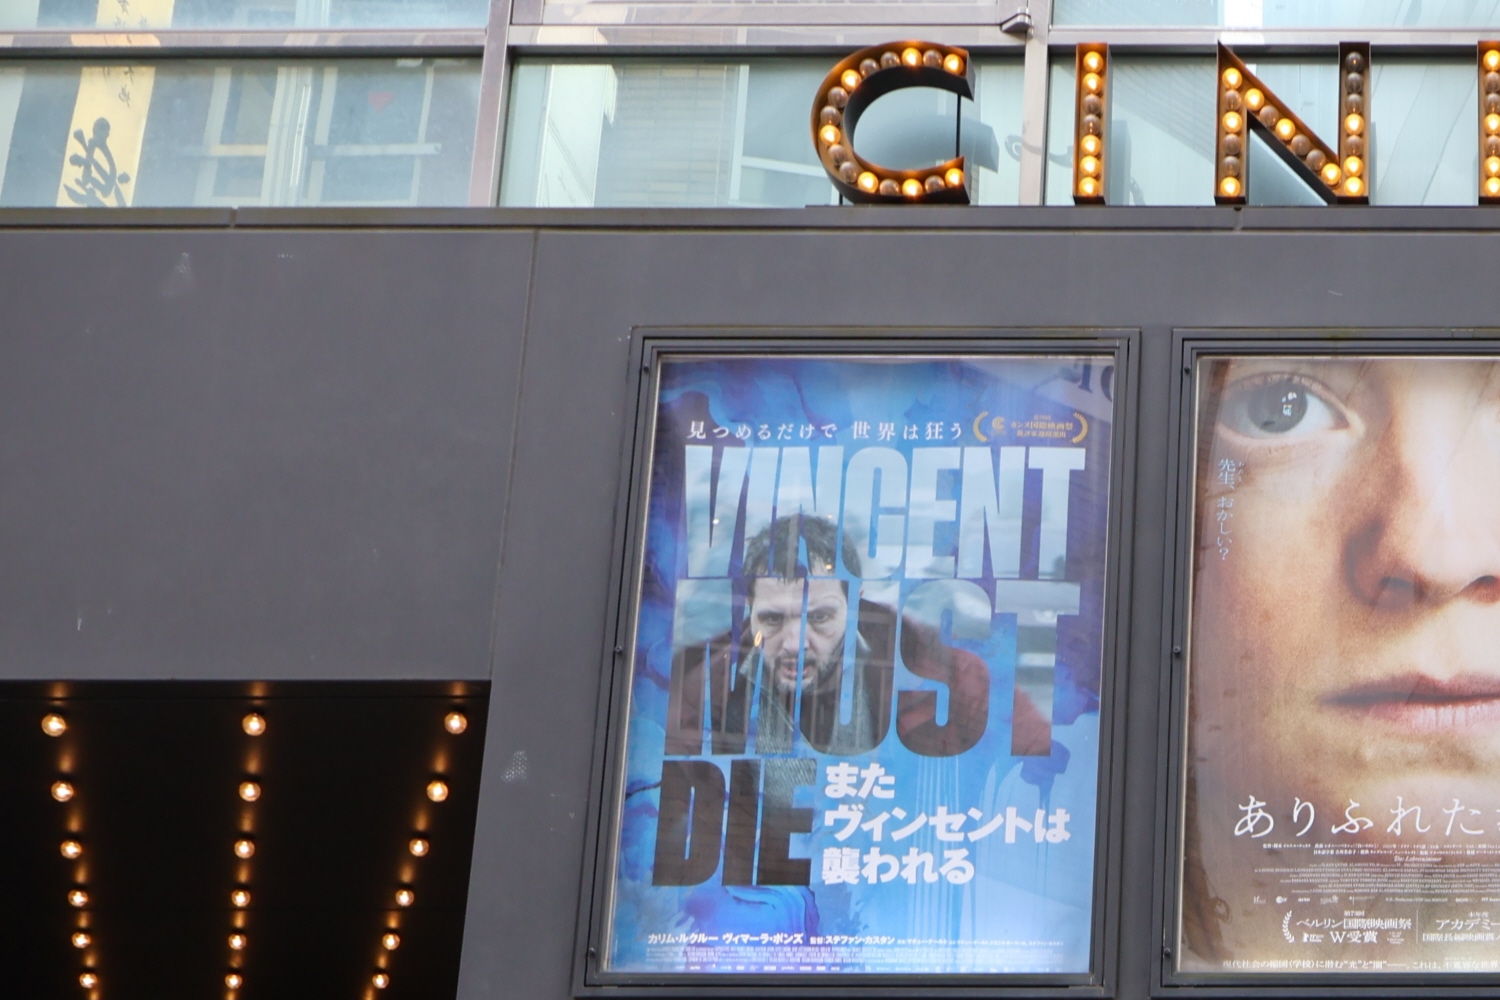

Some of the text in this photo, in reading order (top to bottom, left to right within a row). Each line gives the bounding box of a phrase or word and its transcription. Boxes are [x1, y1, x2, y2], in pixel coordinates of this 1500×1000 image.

[686, 420, 962, 441] 見つめるだけで 世界は狂う
[685, 444, 1086, 579] VINCENT
[664, 578, 1082, 757] MUST
[824, 763, 896, 799] また
[652, 758, 817, 887] DIE
[824, 805, 1072, 844] ヴィンセントは
[822, 848, 976, 885] 襲われる
[1296, 918, 1412, 929] ベルリン国際映画祭
[1329, 931, 1378, 943] W受賞
